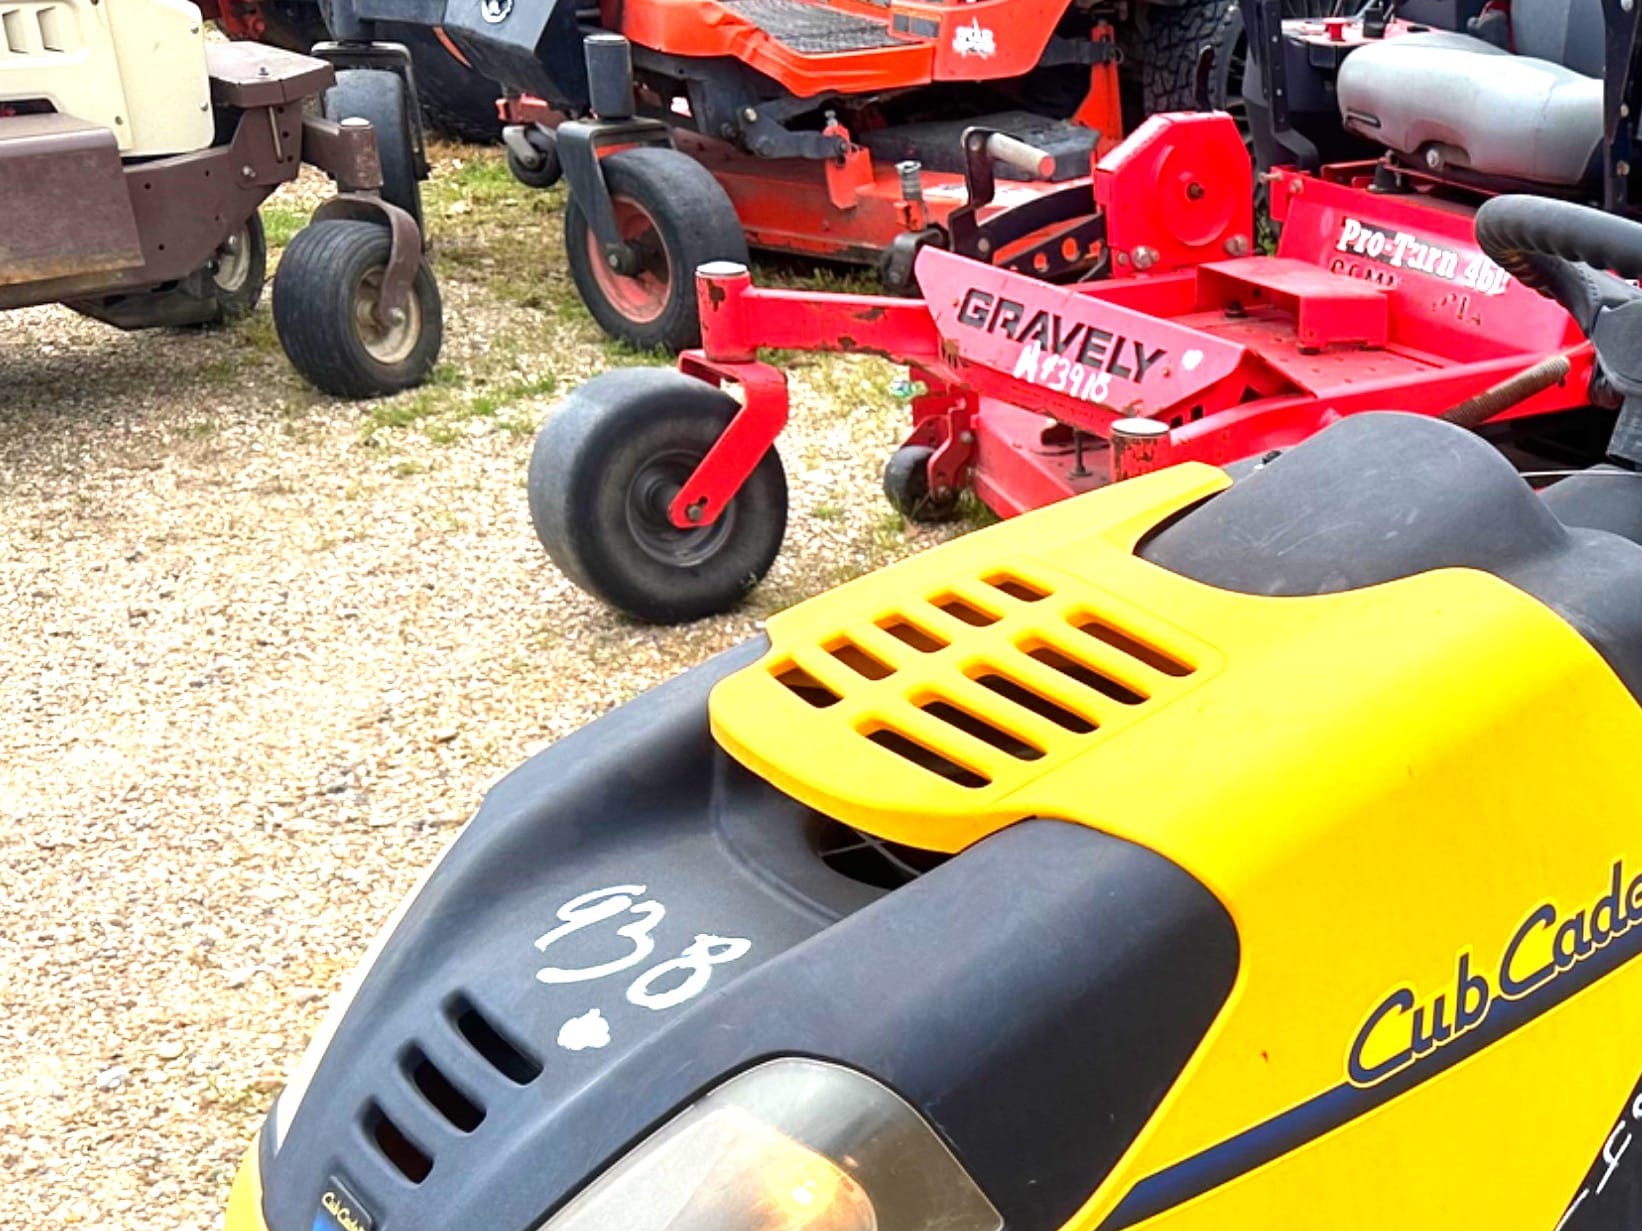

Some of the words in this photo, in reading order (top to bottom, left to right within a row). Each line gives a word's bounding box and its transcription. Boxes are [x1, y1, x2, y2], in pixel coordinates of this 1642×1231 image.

[957, 287, 1167, 383] GRAVELY
[533, 884, 752, 1011] 938
[1348, 951, 1490, 1086] Cub
